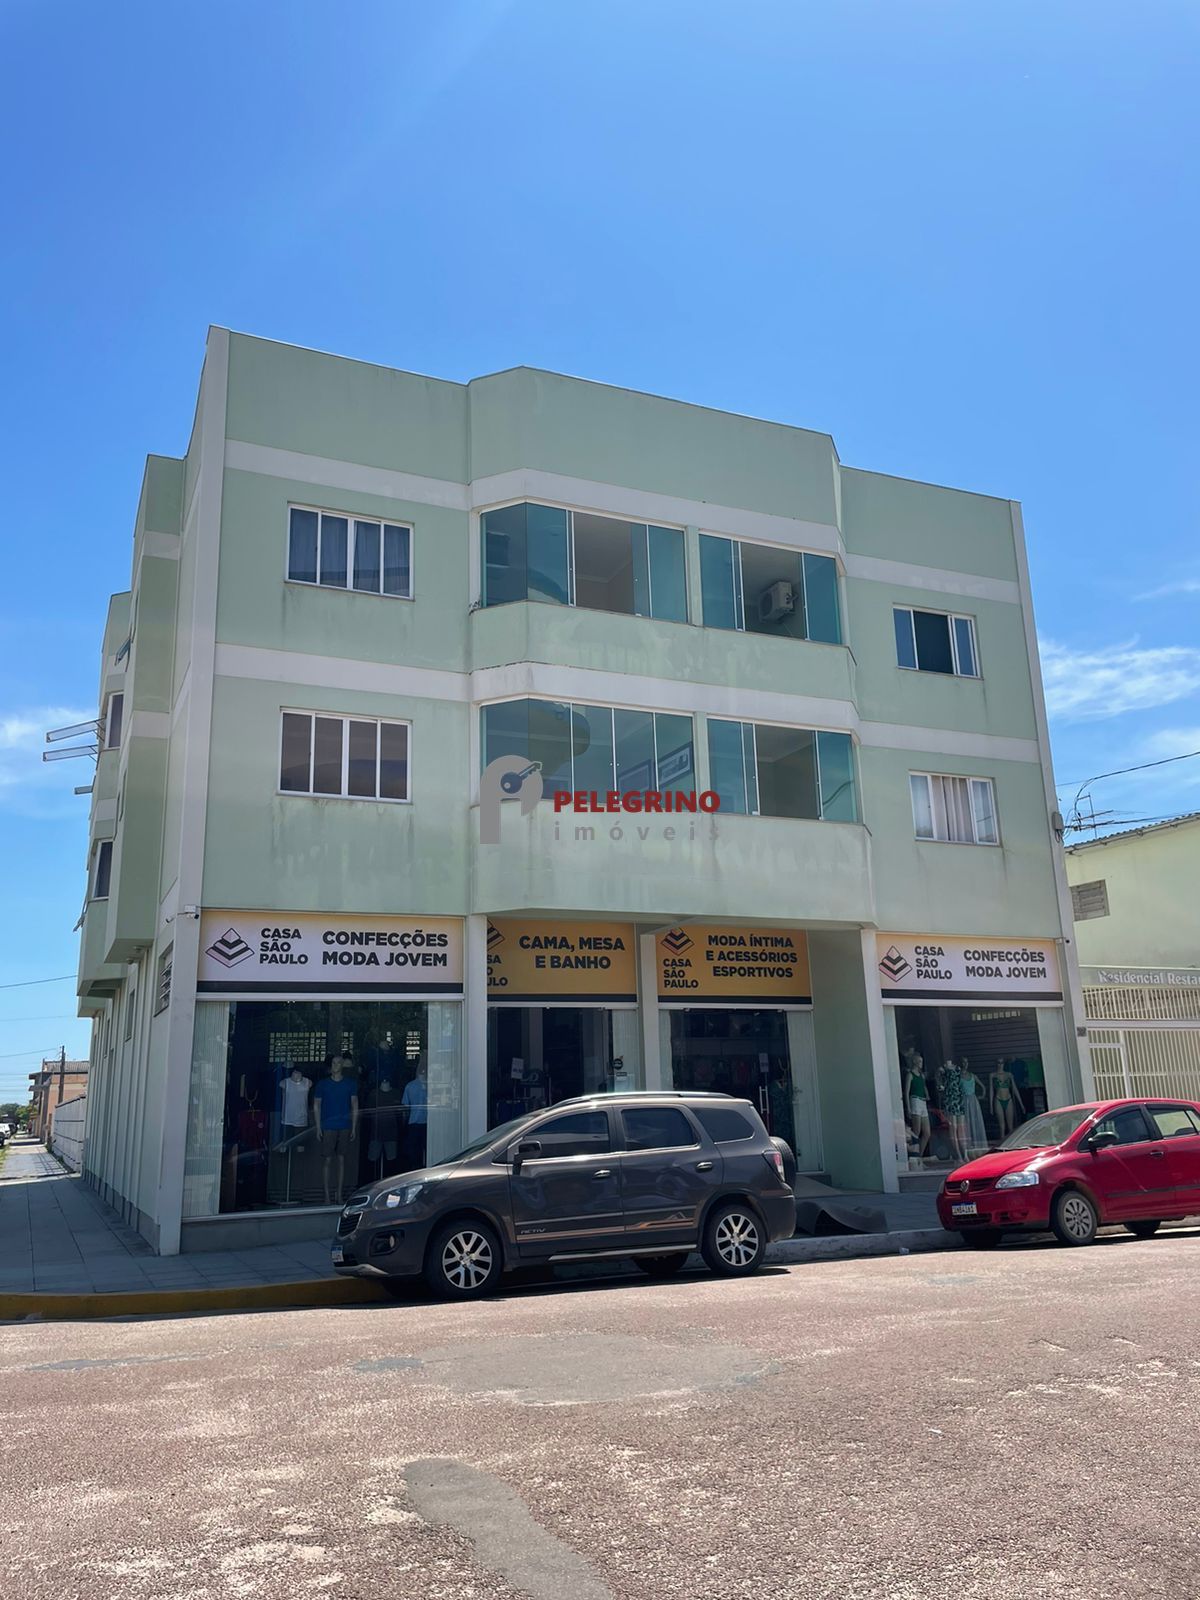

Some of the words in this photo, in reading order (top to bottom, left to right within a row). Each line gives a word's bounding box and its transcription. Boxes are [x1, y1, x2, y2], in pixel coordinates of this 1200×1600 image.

[261, 928, 302, 939] CASA
[322, 929, 449, 948] CONFECÇÕES
[260, 938, 291, 952] SÃO
[519, 935, 576, 952] CAMA,
[579, 936, 625, 951] MESA
[708, 935, 747, 947] MODA
[750, 933, 794, 948] ÍNTIMA
[706, 951, 714, 961] E
[717, 949, 798, 963] ACESSÓRIOS
[914, 945, 945, 957] CASA
[963, 949, 1046, 964] CONFECÇÕES
[259, 953, 308, 965] PAULO
[322, 951, 380, 966] MODA
[384, 953, 448, 967] JOVEM
[535, 955, 546, 968] E
[550, 955, 611, 970] BANHO
[663, 958, 692, 968] CASA
[916, 956, 939, 969] SÃO
[664, 967, 686, 978] SÃO
[712, 966, 793, 978] ESPORTIVOS
[916, 969, 953, 980] PAULO
[966, 966, 1004, 978] MODA
[1006, 967, 1047, 979] JOVEM
[1098, 970, 1164, 984] Residencial
[1167, 972, 1200, 985] Resta
[663, 979, 699, 989] PAULO
